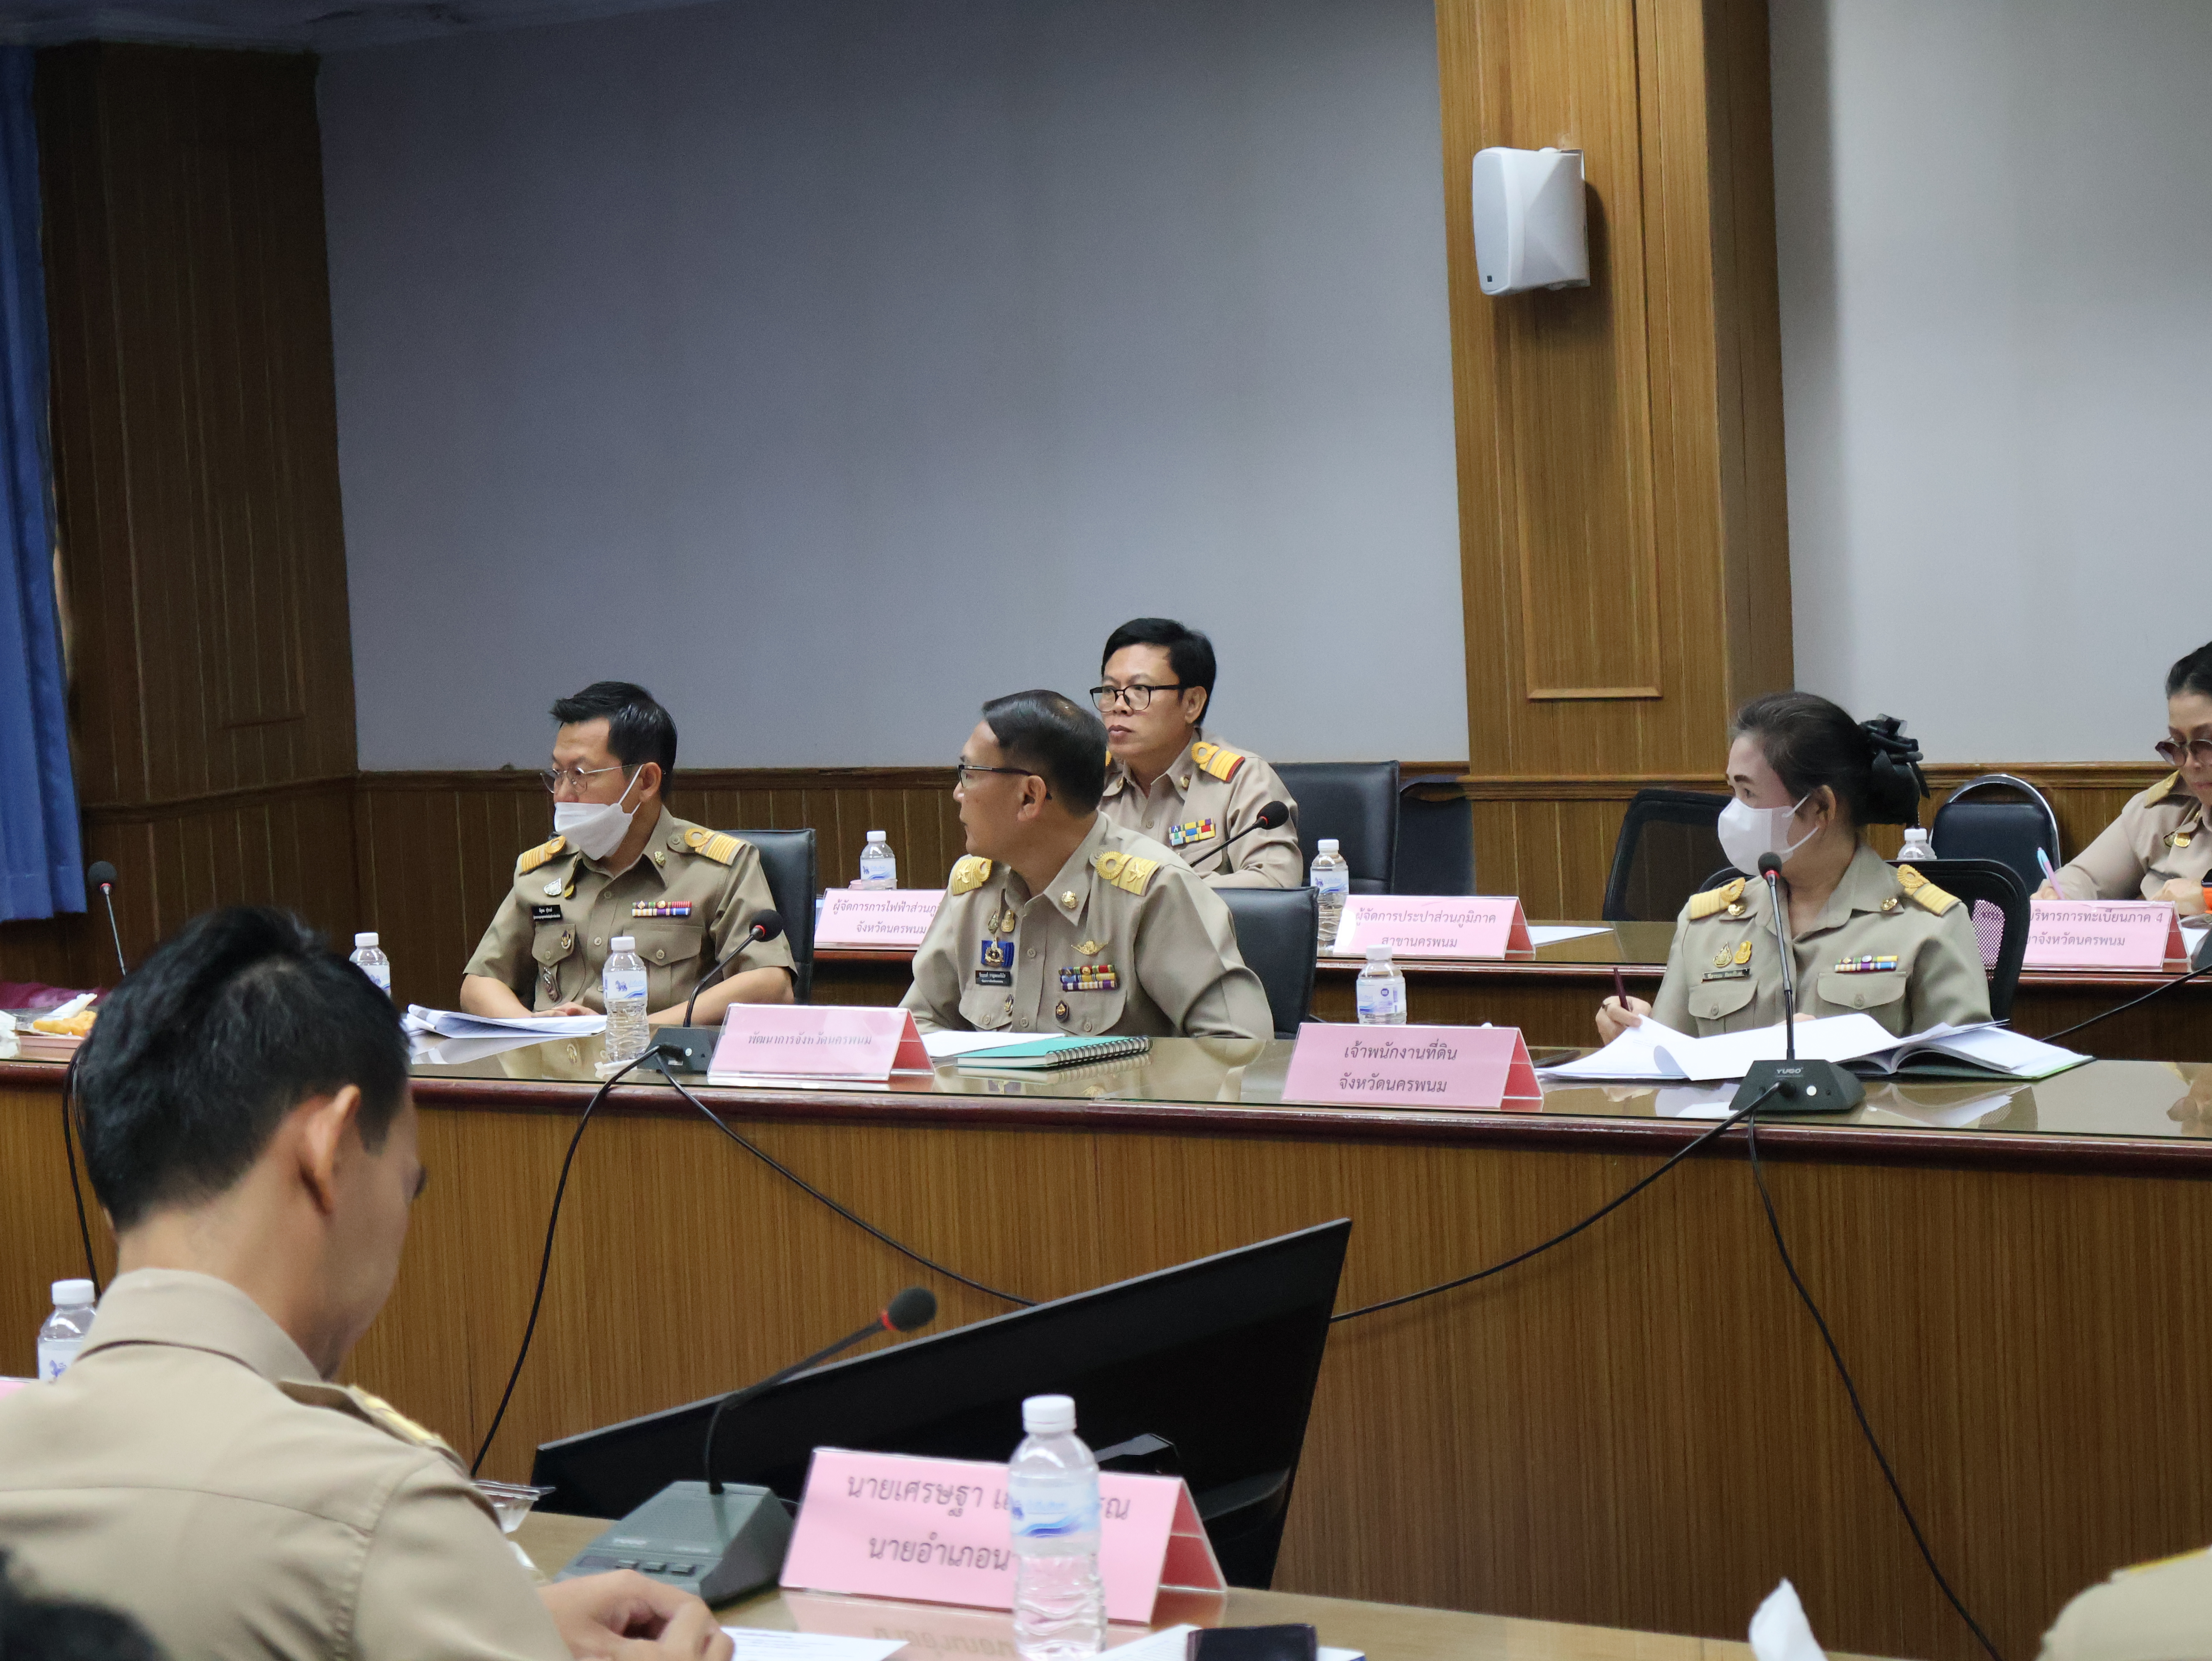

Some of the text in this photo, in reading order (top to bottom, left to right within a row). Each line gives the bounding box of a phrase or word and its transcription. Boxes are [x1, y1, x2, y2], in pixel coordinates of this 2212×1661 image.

[832, 898, 938, 917] ผู้จัดการการไฟฟ้าส่วนภู
[1355, 907, 1496, 928] ผู้จัดการประปาส่วนภูมิภาค
[2156, 912, 2163, 923] 4
[856, 920, 927, 934] จังหวัดนครพนม
[1381, 936, 1458, 948] สาขานครพนม
[748, 1031, 872, 1046] พัฒนาการจังหวัดนครพนม
[1344, 1038, 1458, 1061] เจ้าพนักงานที่ดิน
[1339, 1071, 1448, 1093] จังหวัดนครพนม
[848, 1475, 984, 1518] นายเศรษฐา
[869, 1531, 1014, 1572] นายอำเภอน
